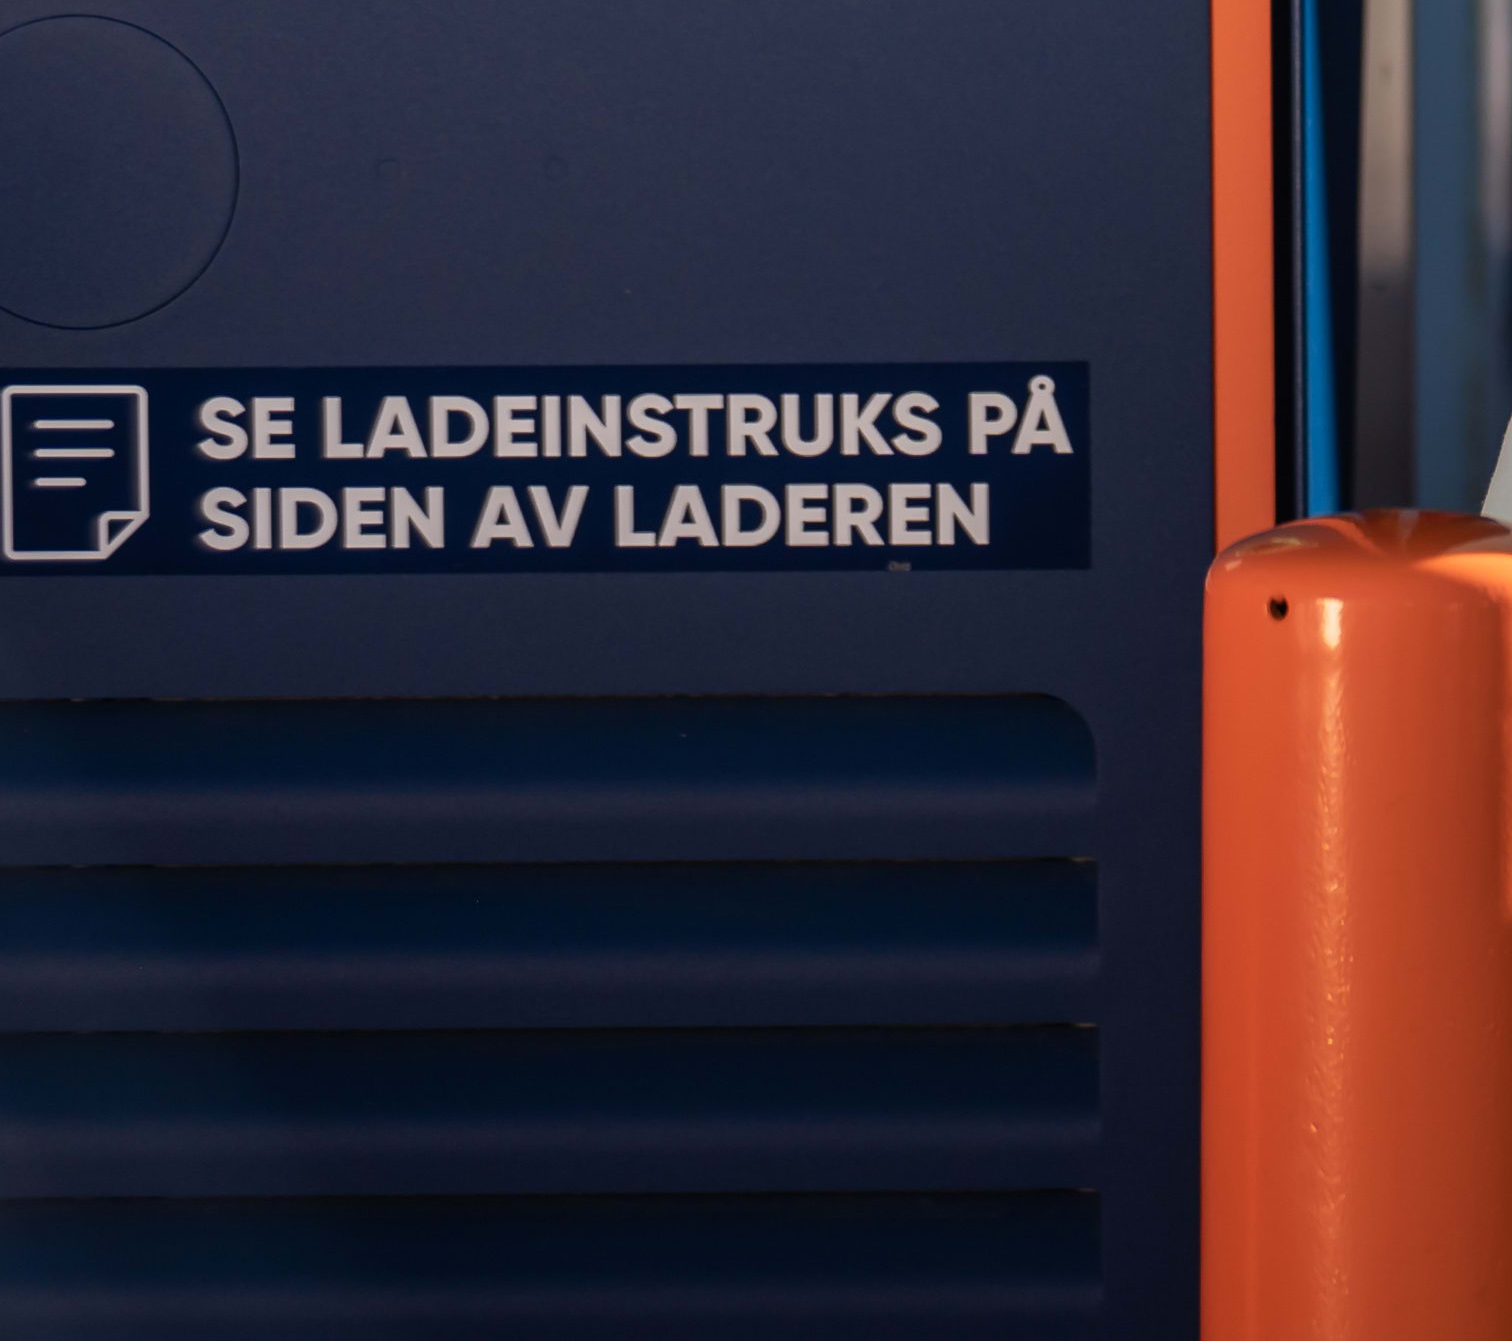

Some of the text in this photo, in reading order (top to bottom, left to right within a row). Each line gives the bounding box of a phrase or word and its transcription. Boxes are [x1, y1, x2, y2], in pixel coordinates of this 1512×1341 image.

[198, 375, 1074, 460] SE LADEINSTRUKS PÅ
[198, 482, 990, 551] SIDEN AV LADEREN
